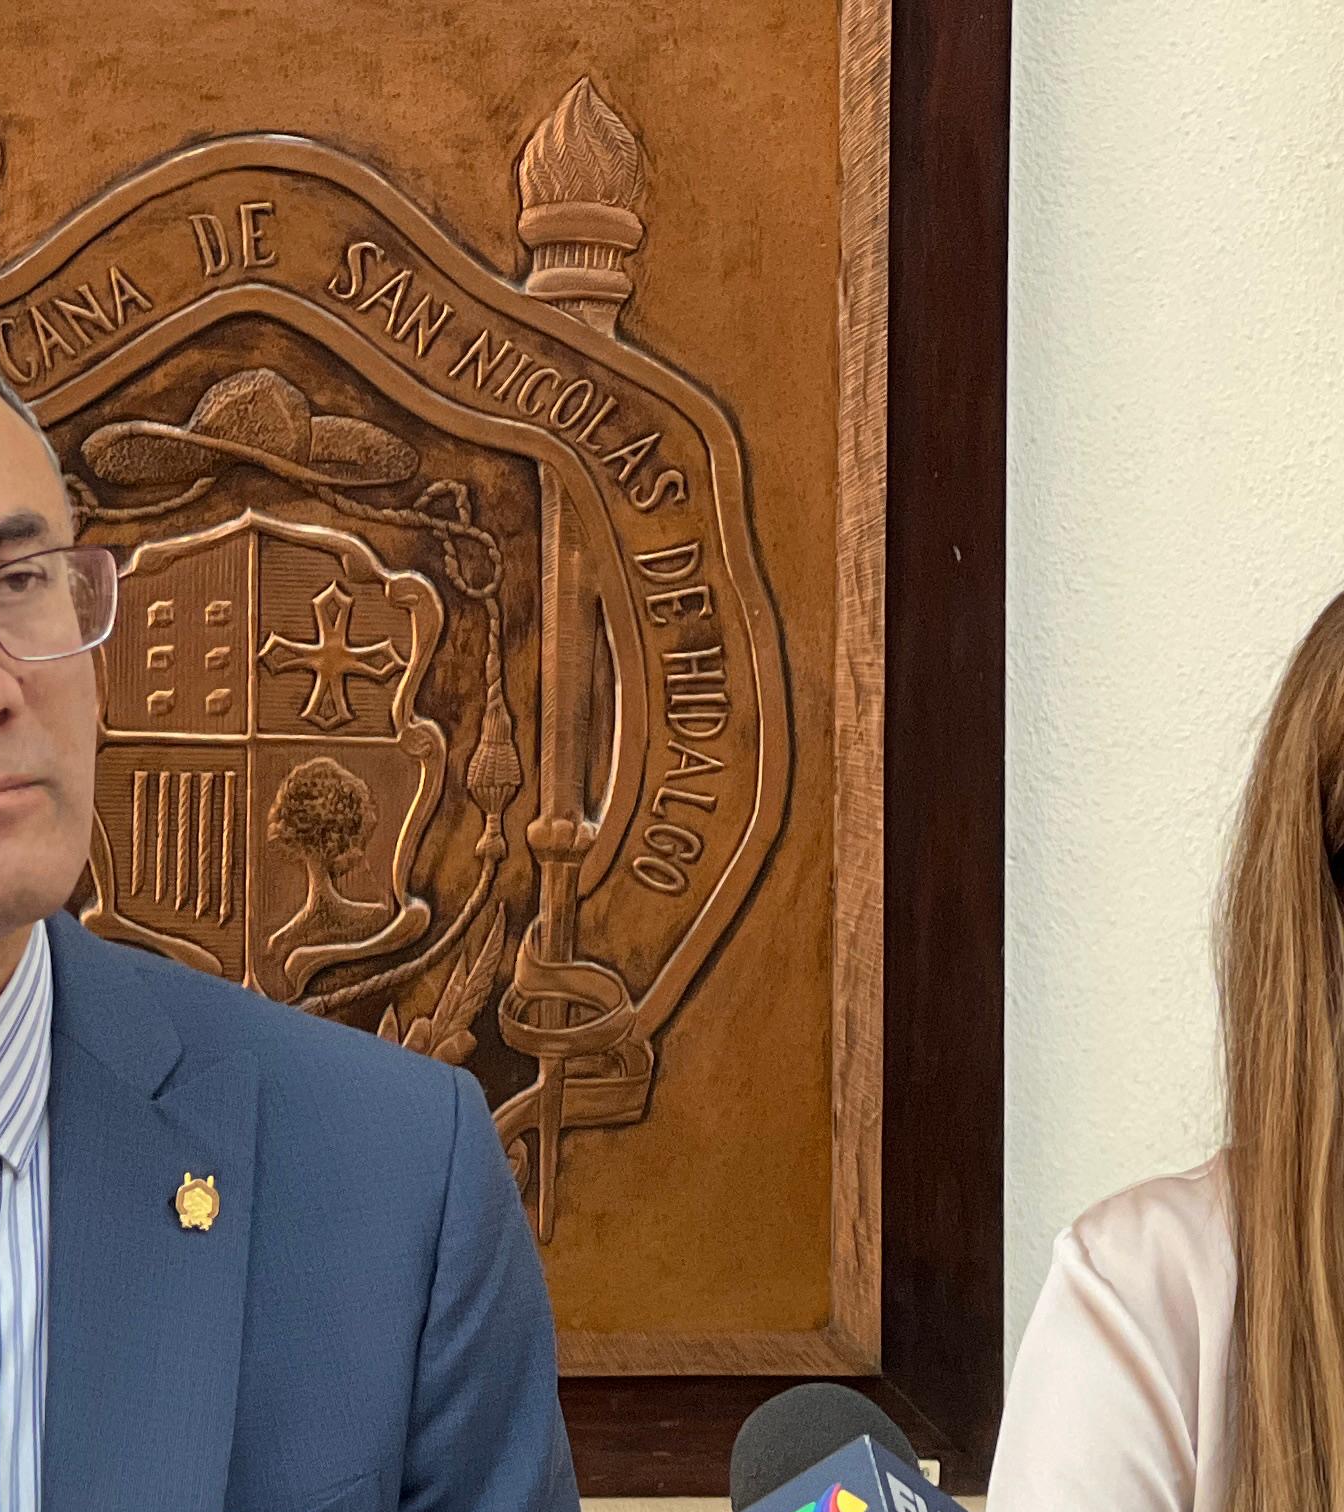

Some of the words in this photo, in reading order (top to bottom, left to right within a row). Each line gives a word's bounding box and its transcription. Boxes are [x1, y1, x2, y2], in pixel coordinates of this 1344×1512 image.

[188, 201, 278, 277] DE
[328, 241, 453, 359] SAN
[448, 328, 687, 512] NICOLAS
[633, 541, 713, 625] DE
[633, 645, 729, 895] HIDALGO
